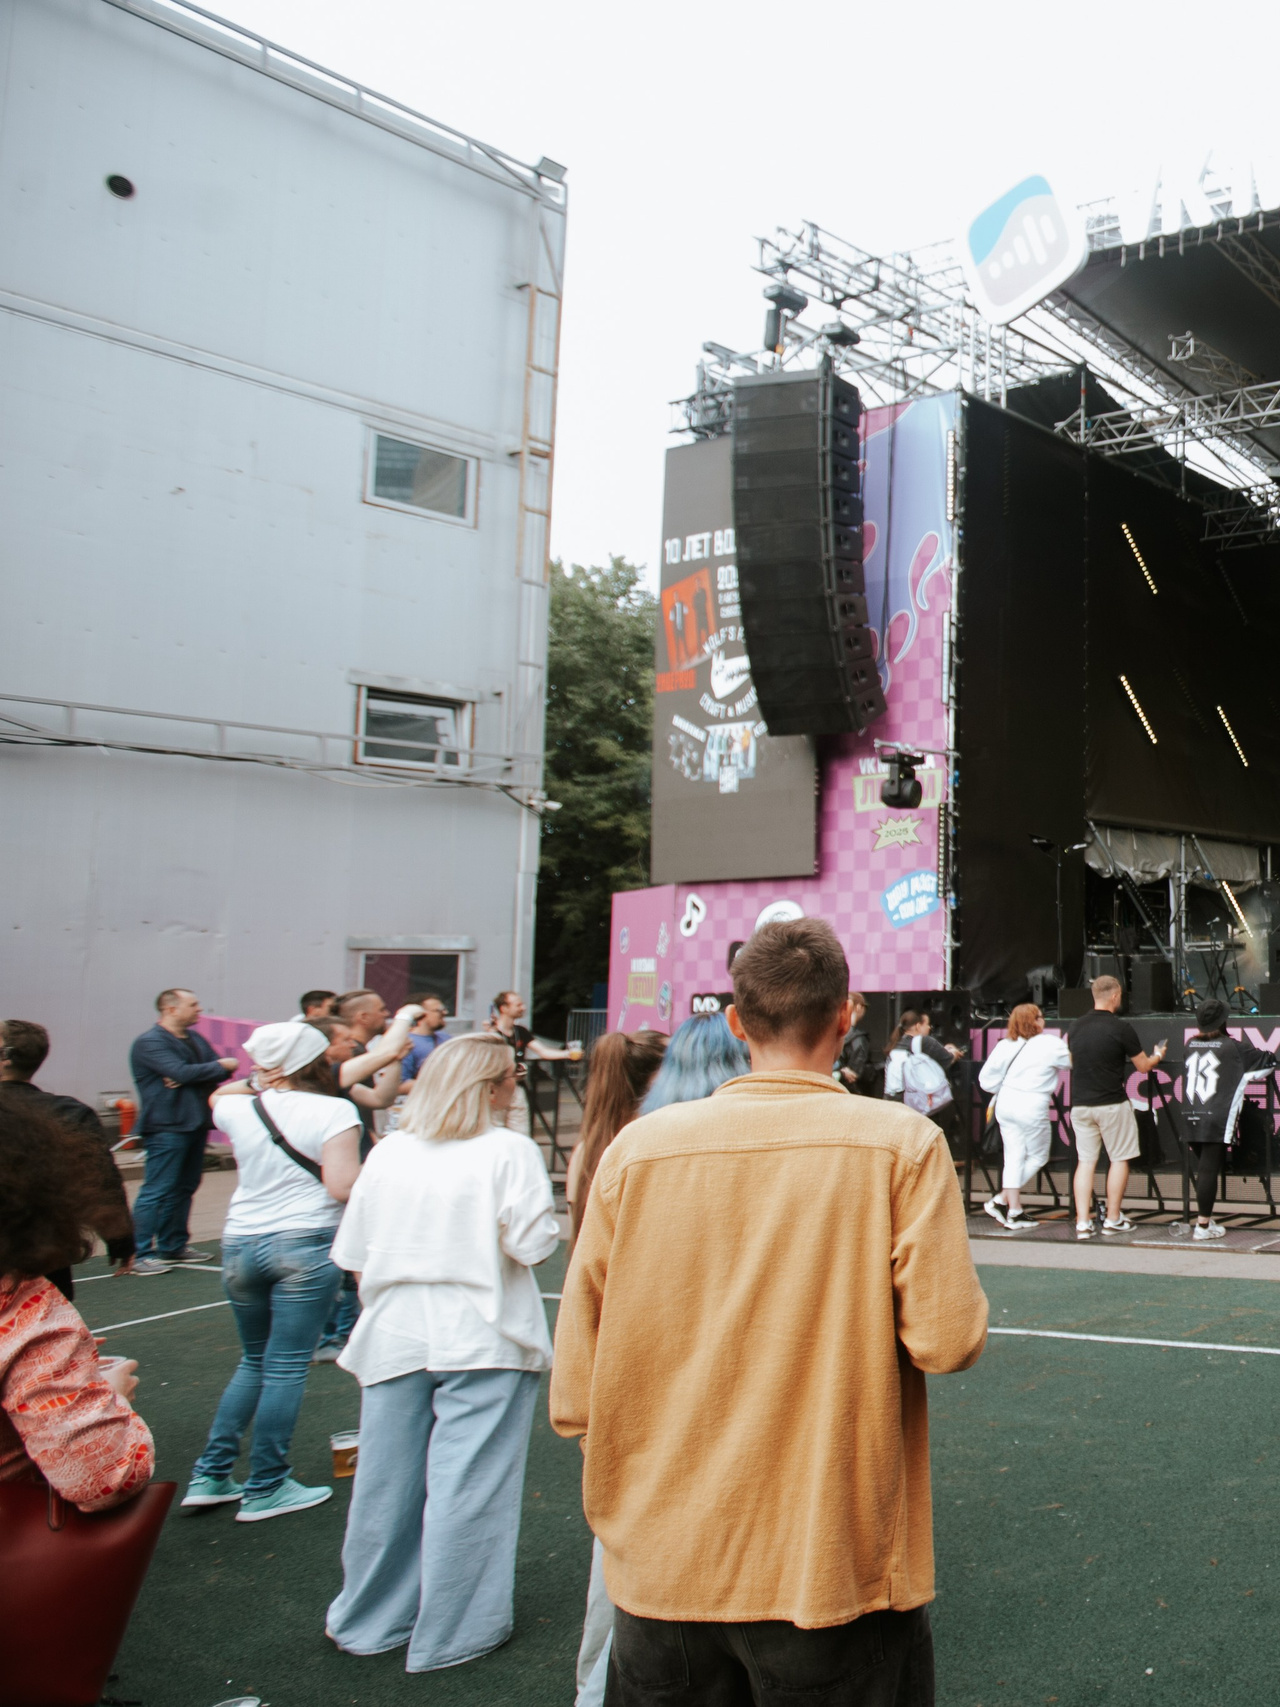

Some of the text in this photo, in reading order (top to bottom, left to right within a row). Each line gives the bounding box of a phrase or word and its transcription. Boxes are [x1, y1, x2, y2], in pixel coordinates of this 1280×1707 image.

[665, 538, 682, 565] 10
[682, 532, 712, 562] ЛЕТ
[1185, 1049, 1221, 1105] 13
